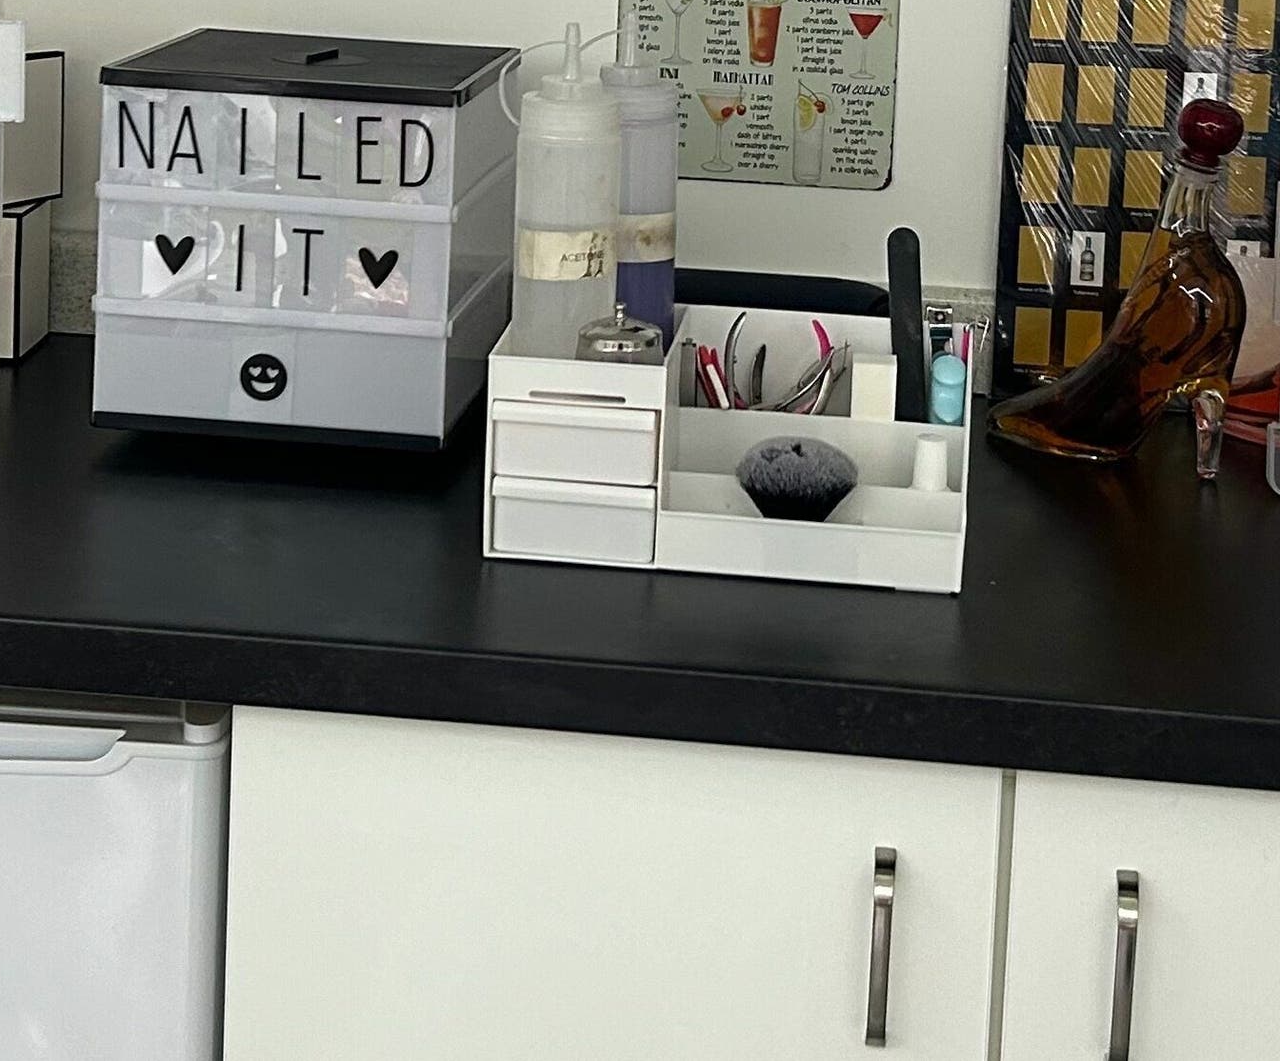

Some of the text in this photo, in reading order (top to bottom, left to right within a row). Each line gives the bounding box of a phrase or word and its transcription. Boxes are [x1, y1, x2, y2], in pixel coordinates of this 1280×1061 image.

[831, 83, 890, 96] TOM COLLINS
[118, 100, 435, 188] NAILED
[235, 224, 324, 296] IT
